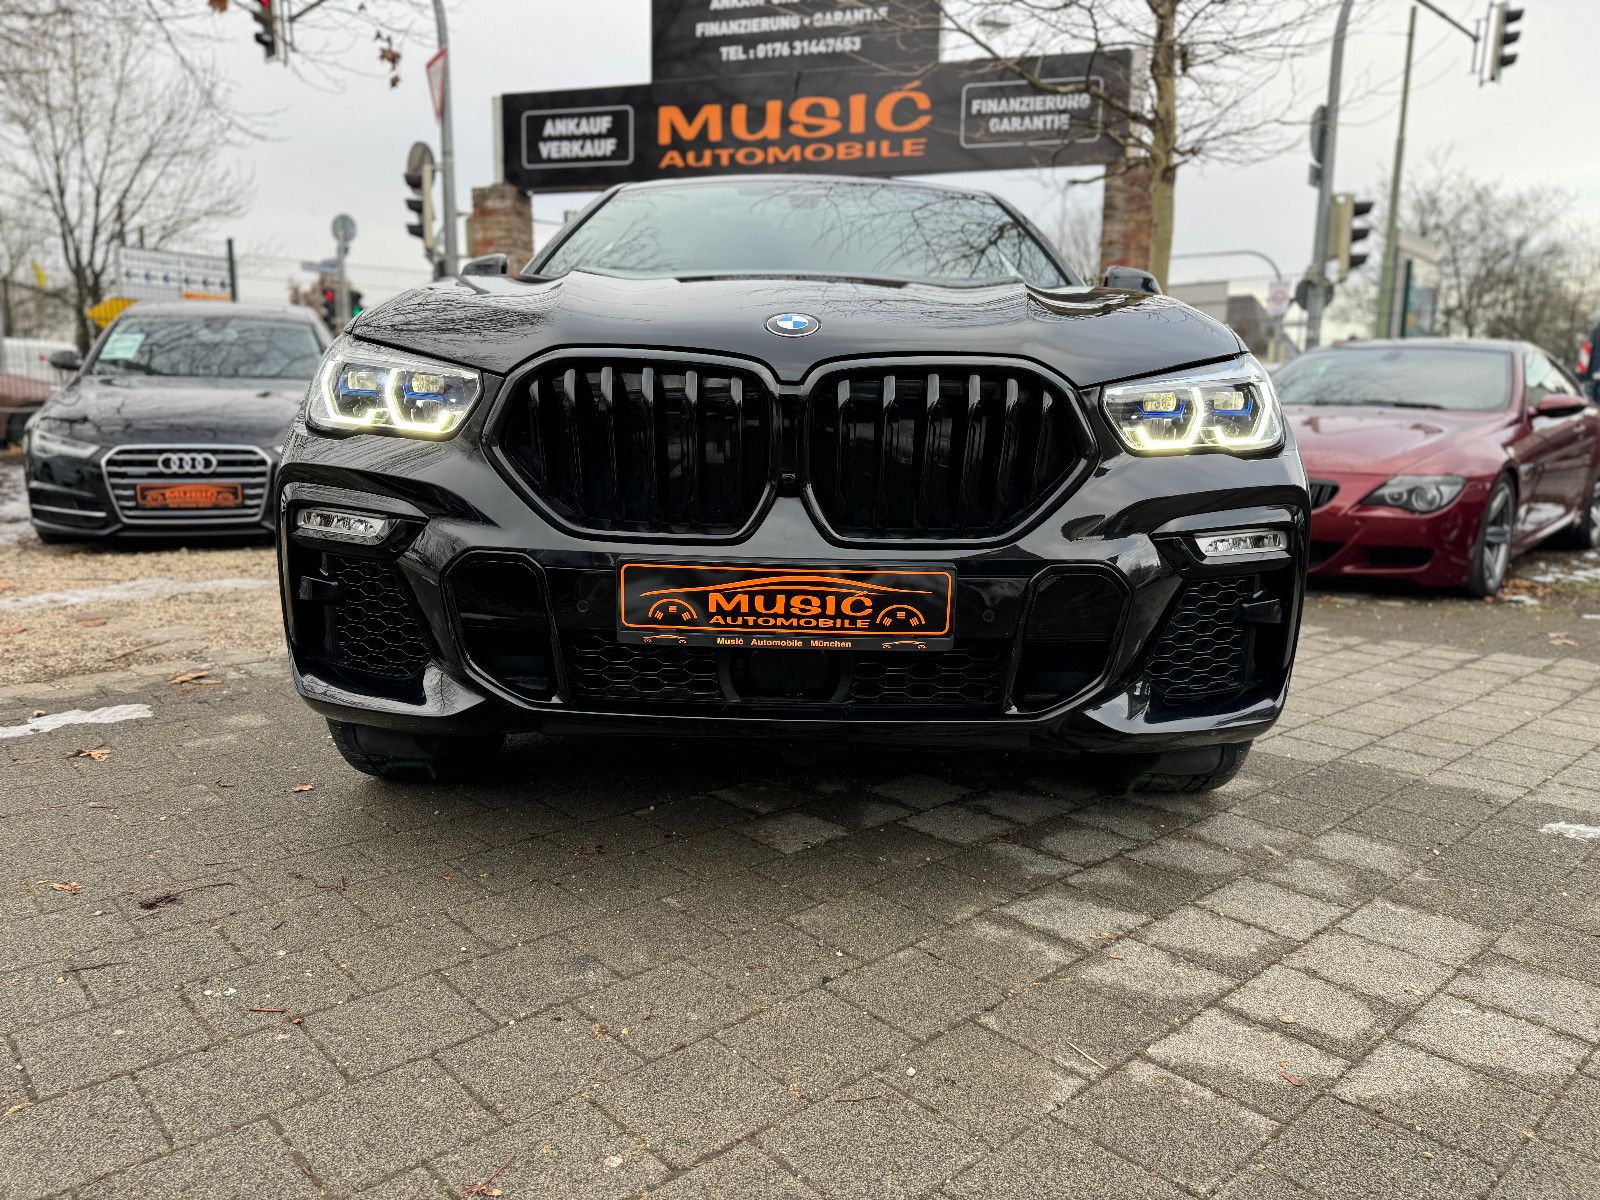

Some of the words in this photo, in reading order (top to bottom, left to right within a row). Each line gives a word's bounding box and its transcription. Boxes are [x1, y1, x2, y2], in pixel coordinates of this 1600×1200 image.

[695, 15, 801, 38] FINANZIERUNG
[756, 41, 790, 59] 0176
[792, 36, 862, 56] 31447653
[971, 92, 1091, 115] FINANZIERUNG
[542, 114, 613, 138] ANKAUF
[989, 113, 1071, 133] GARANTIE
[538, 137, 617, 159] VERKAUF
[658, 137, 928, 169] AUTOMOBILE
[709, 615, 871, 628] AUTOMOBILE
[751, 638, 803, 647] Automobile
[810, 640, 852, 648] München
